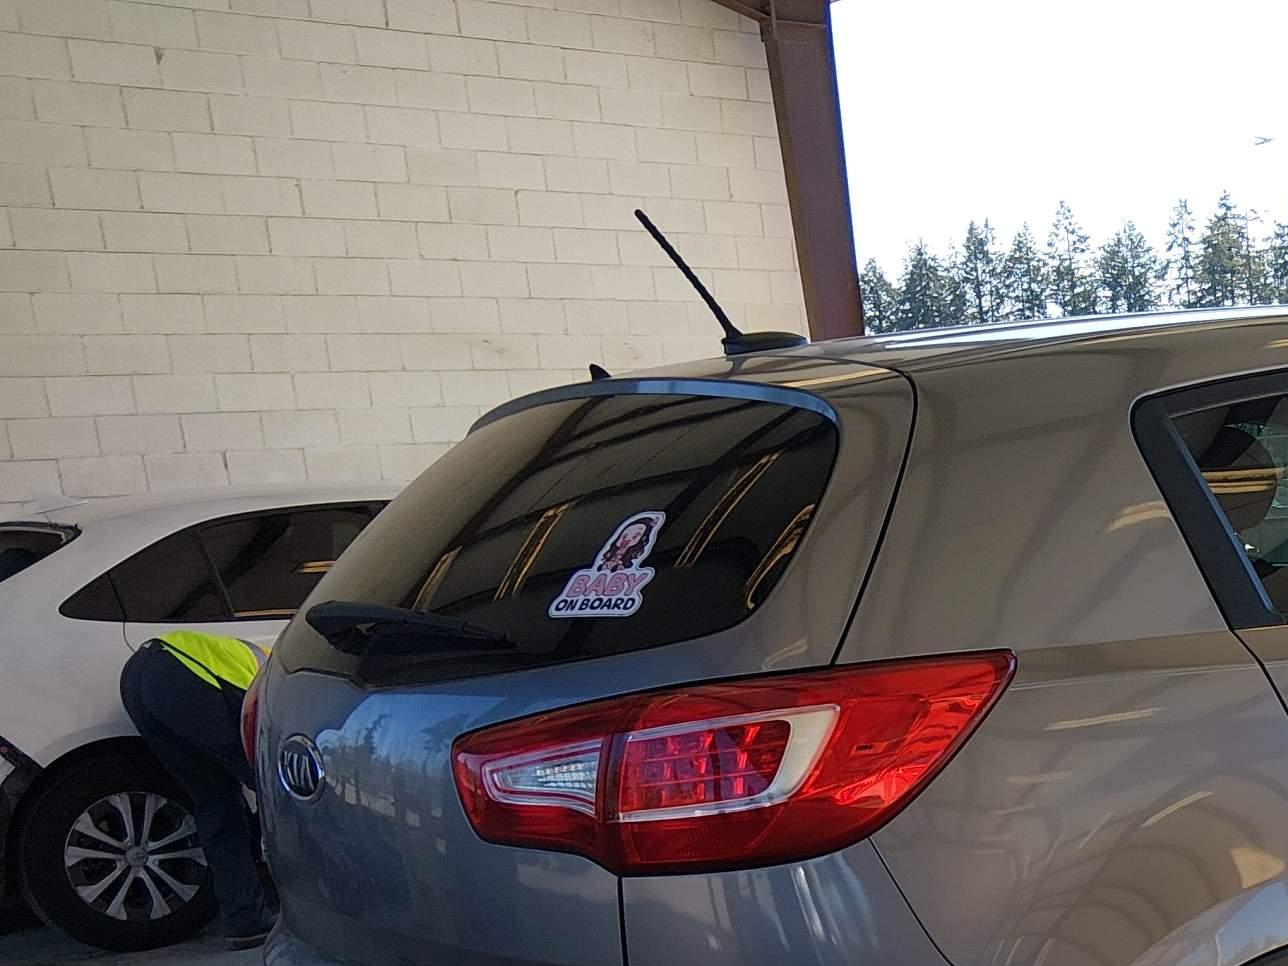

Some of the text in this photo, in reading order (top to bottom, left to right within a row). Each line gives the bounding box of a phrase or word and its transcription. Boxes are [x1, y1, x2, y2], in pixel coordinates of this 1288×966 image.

[566, 573, 647, 597] BABY
[554, 597, 636, 611] ON BOARD
[283, 749, 315, 791] KIA
